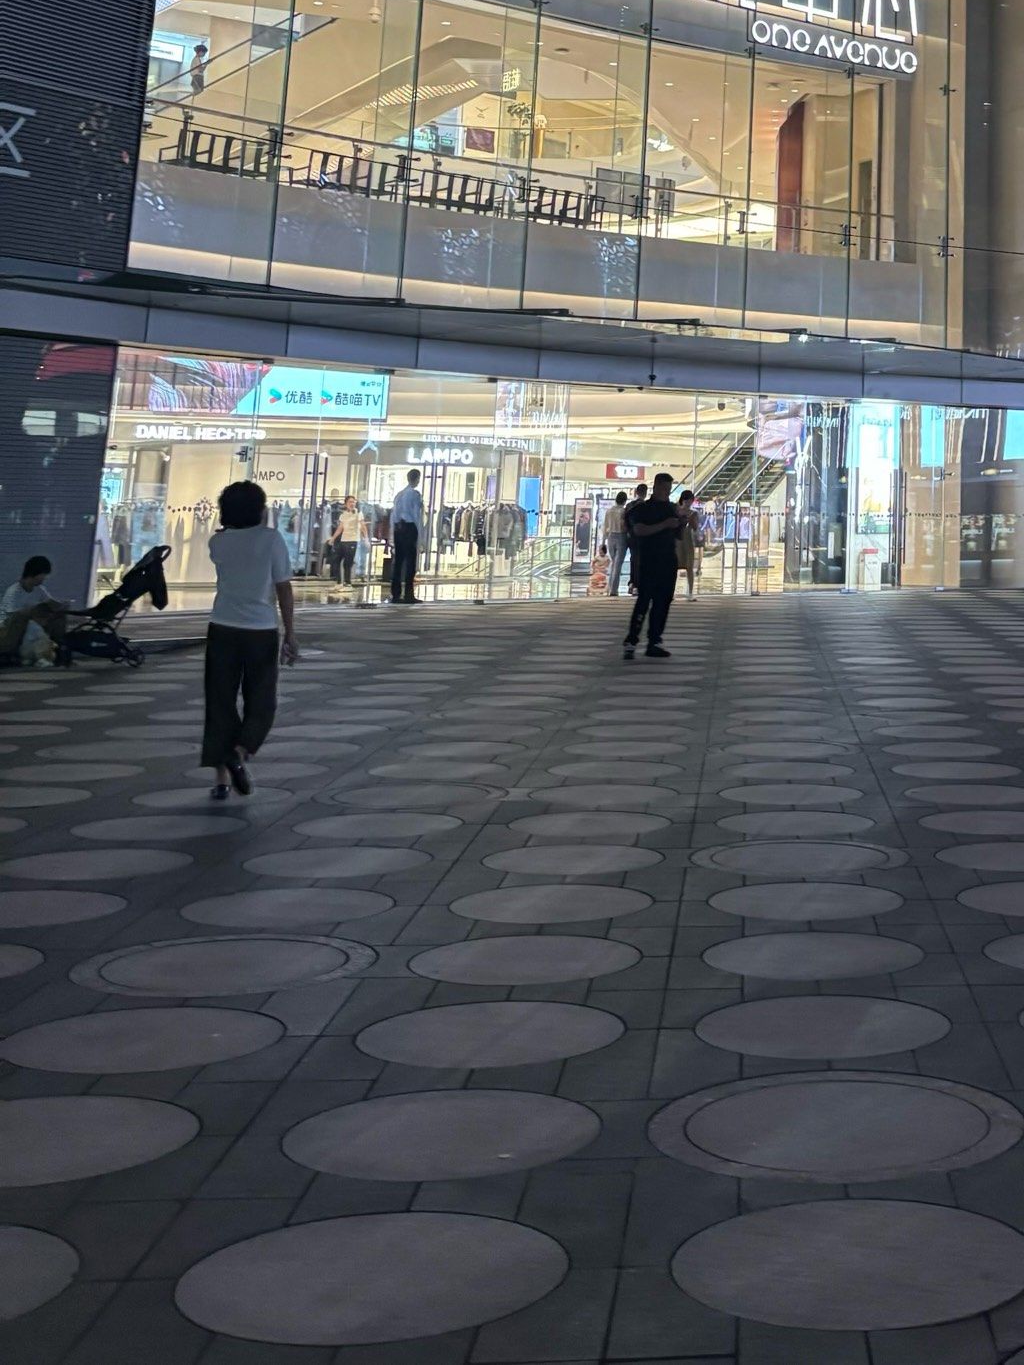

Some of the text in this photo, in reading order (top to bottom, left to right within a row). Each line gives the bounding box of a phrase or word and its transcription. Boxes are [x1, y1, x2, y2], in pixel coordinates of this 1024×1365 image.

[752, 20, 810, 53] one
[284, 390, 312, 404] 优酷
[135, 424, 192, 441] DANIEL
[406, 448, 474, 465] LAMPO
